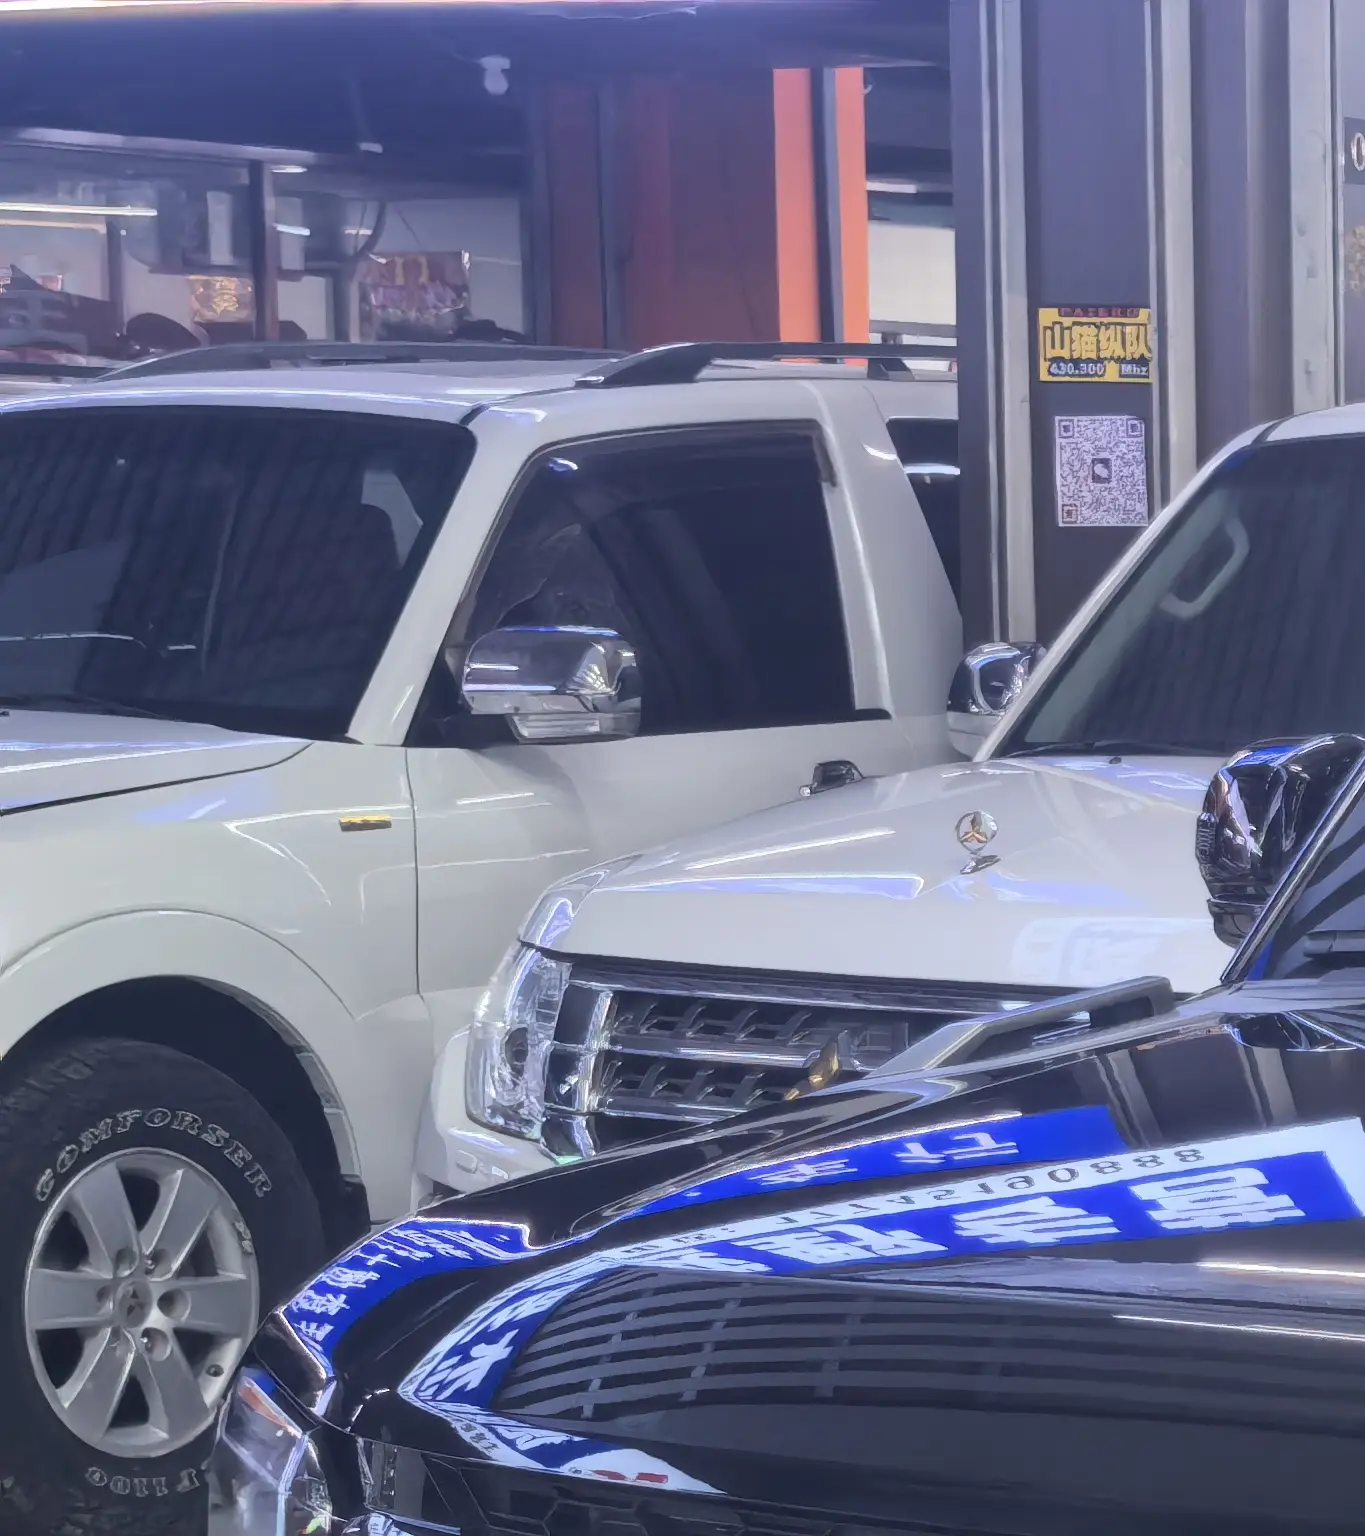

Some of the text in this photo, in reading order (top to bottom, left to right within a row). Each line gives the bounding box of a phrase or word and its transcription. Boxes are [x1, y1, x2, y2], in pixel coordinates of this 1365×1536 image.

[1044, 322, 1153, 360] 山猫纵队
[36, 1107, 272, 1202] COMFORSER
